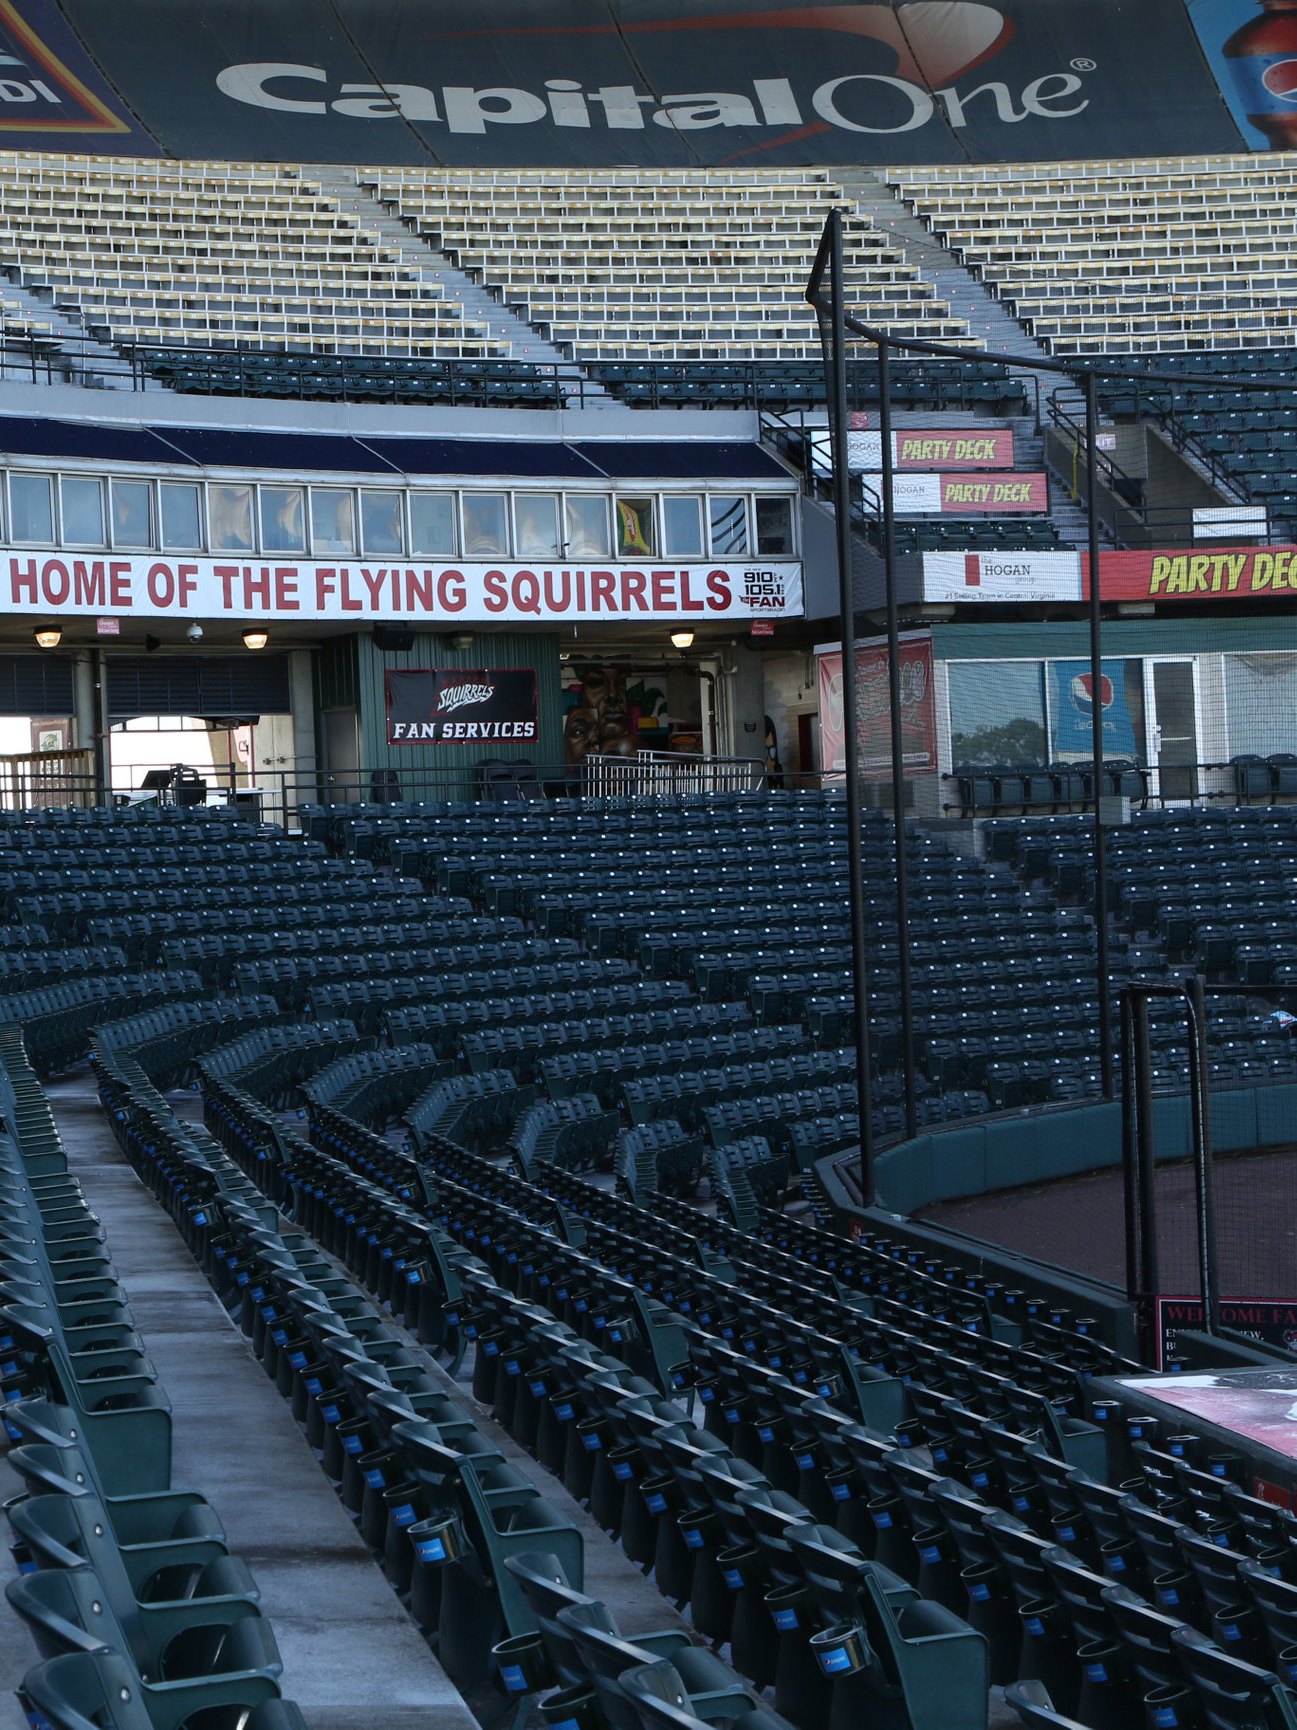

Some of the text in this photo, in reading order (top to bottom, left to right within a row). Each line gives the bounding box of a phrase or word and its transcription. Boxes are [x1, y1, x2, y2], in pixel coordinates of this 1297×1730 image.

[901, 439, 953, 461] PARTY
[954, 438, 998, 461] DECK
[944, 483, 991, 503] PARTY
[992, 482, 1033, 503] DECK
[744, 572, 773, 583] 910
[984, 564, 1031, 576] HOGAN
[1148, 551, 1249, 595] PARTY
[9, 558, 732, 616] HOME OF THE FLYING SQUIRRELS
[744, 584, 781, 596] 105.1
[750, 596, 786, 607] FAN
[437, 683, 495, 713] SQUIRRELS
[392, 721, 535, 739] FAN SERVICES
